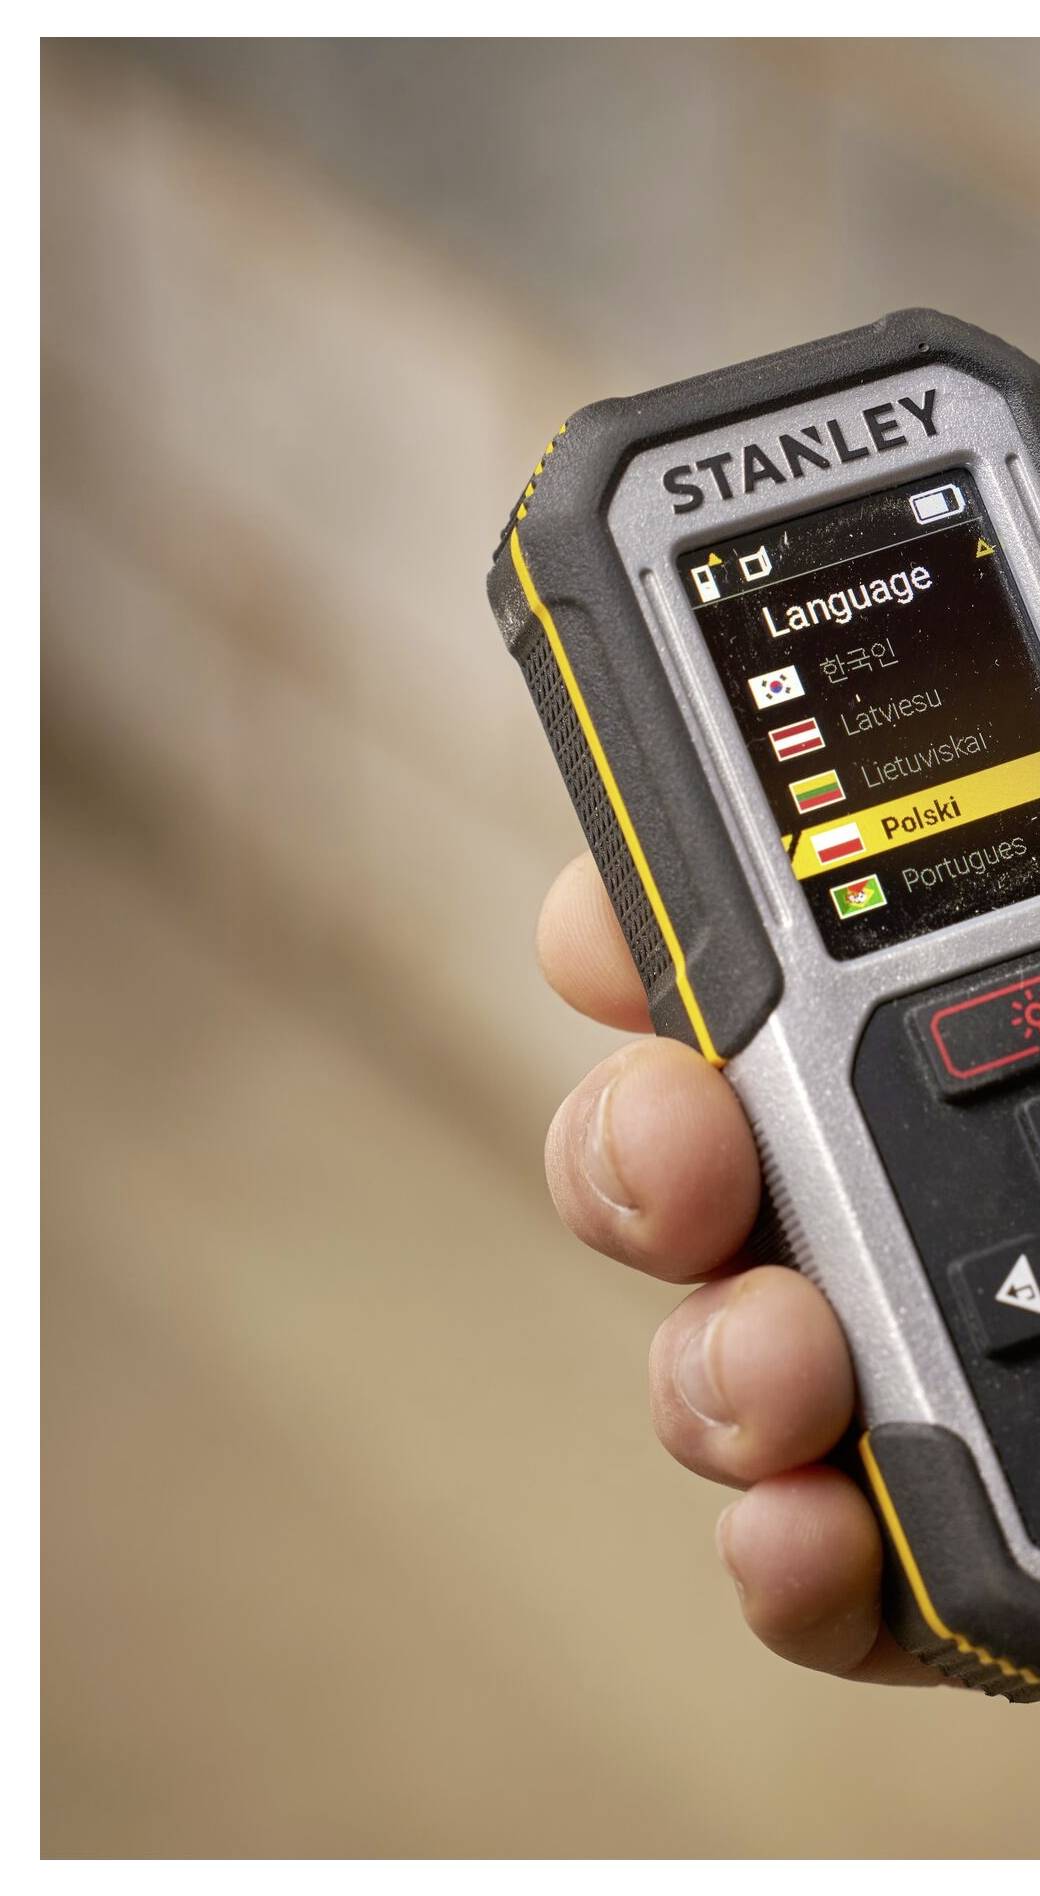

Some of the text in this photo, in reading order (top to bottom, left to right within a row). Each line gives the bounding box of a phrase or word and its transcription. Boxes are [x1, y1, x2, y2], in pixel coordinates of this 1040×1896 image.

[662, 388, 940, 515] STANLEY
[762, 565, 933, 638] Language
[819, 637, 899, 685] 한국인
[840, 686, 943, 738] Latviesu
[861, 729, 988, 789] Lietuviskai
[881, 796, 962, 840] Polski
[902, 835, 1028, 893] Portugues
